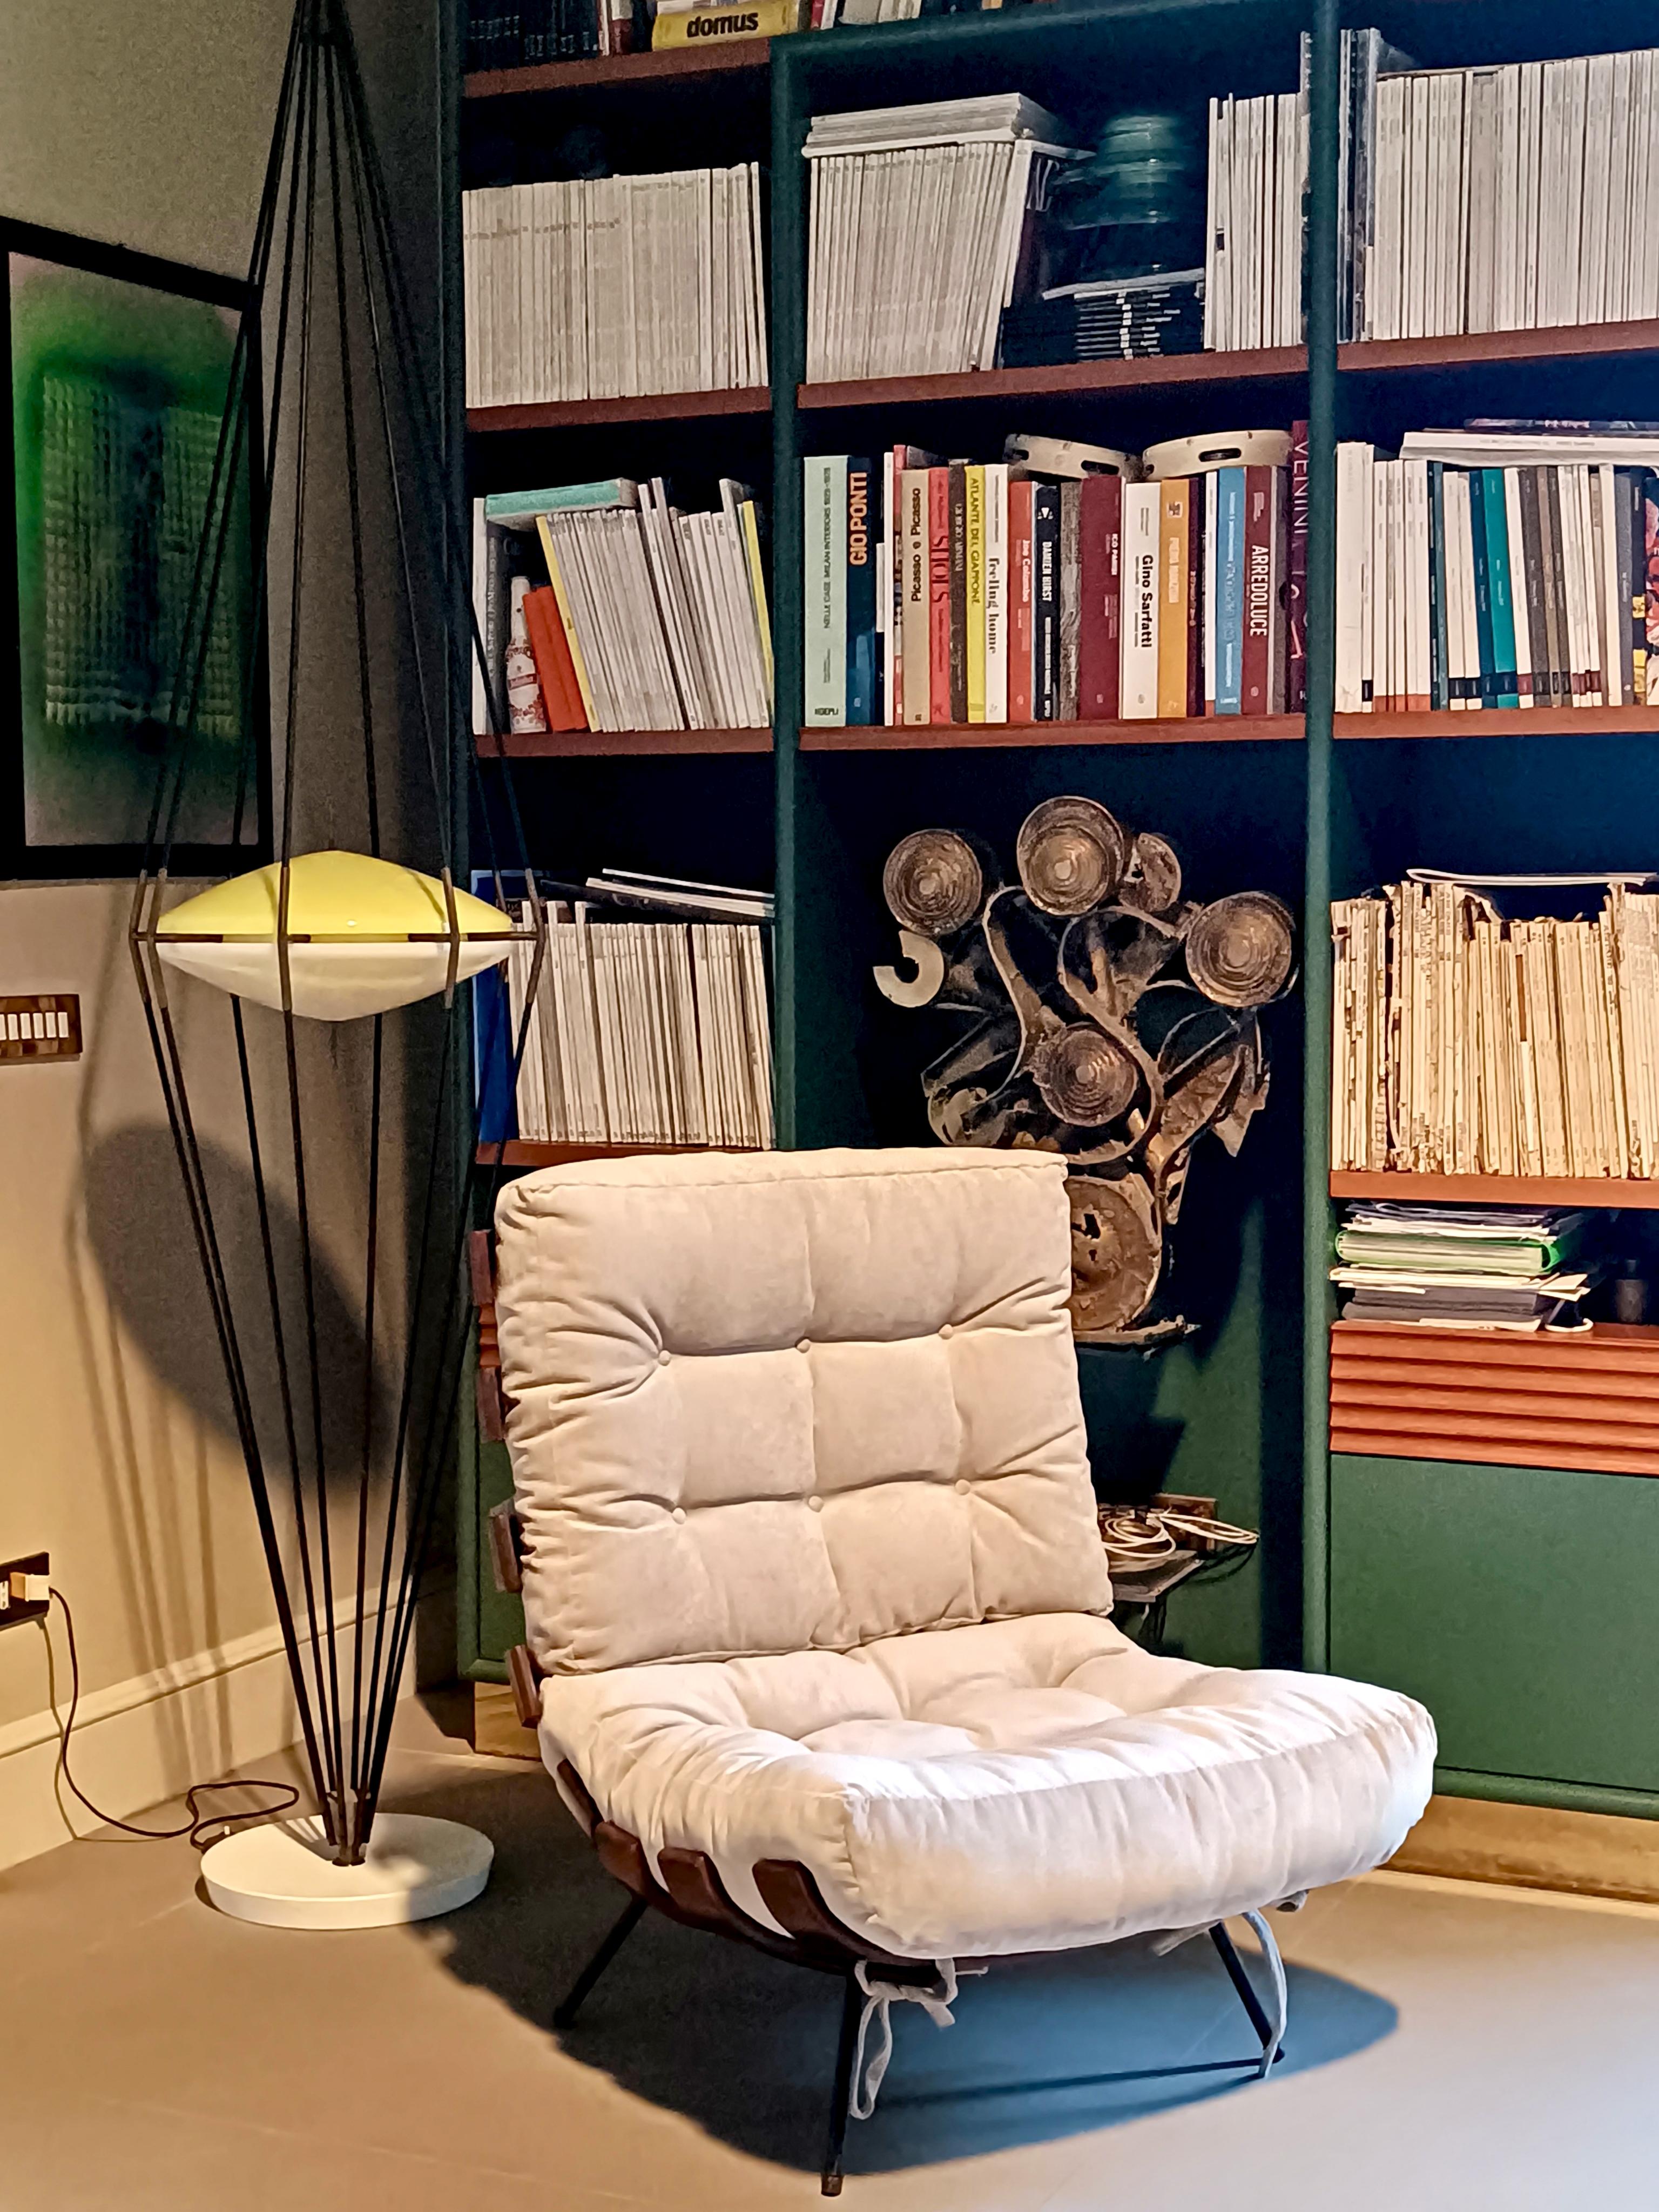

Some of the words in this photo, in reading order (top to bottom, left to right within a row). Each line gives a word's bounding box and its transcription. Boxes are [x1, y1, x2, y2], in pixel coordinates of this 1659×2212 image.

[687, 12, 759, 38] domus
[849, 471, 868, 531] PONTI
[969, 477, 979, 524] ATLANTE
[1294, 440, 1309, 534] VENINI
[823, 508, 831, 550] INTERIORS
[911, 488, 921, 536] Picasso
[849, 534, 867, 565] GIO
[970, 528, 980, 547] DEL
[1022, 539, 1030, 556] Joe
[1042, 541, 1052, 574] DAMIEN
[911, 554, 921, 602] Picasso
[970, 550, 980, 605] GIAPPONE
[987, 557, 1000, 609] feeling
[1022, 558, 1030, 602] Colombo
[1042, 576, 1052, 602] HIRST
[1142, 555, 1154, 588] Gino
[1250, 545, 1269, 637] ARREDOLUCE
[988, 613, 999, 655] home
[1141, 592, 1153, 648] Sarfatti
